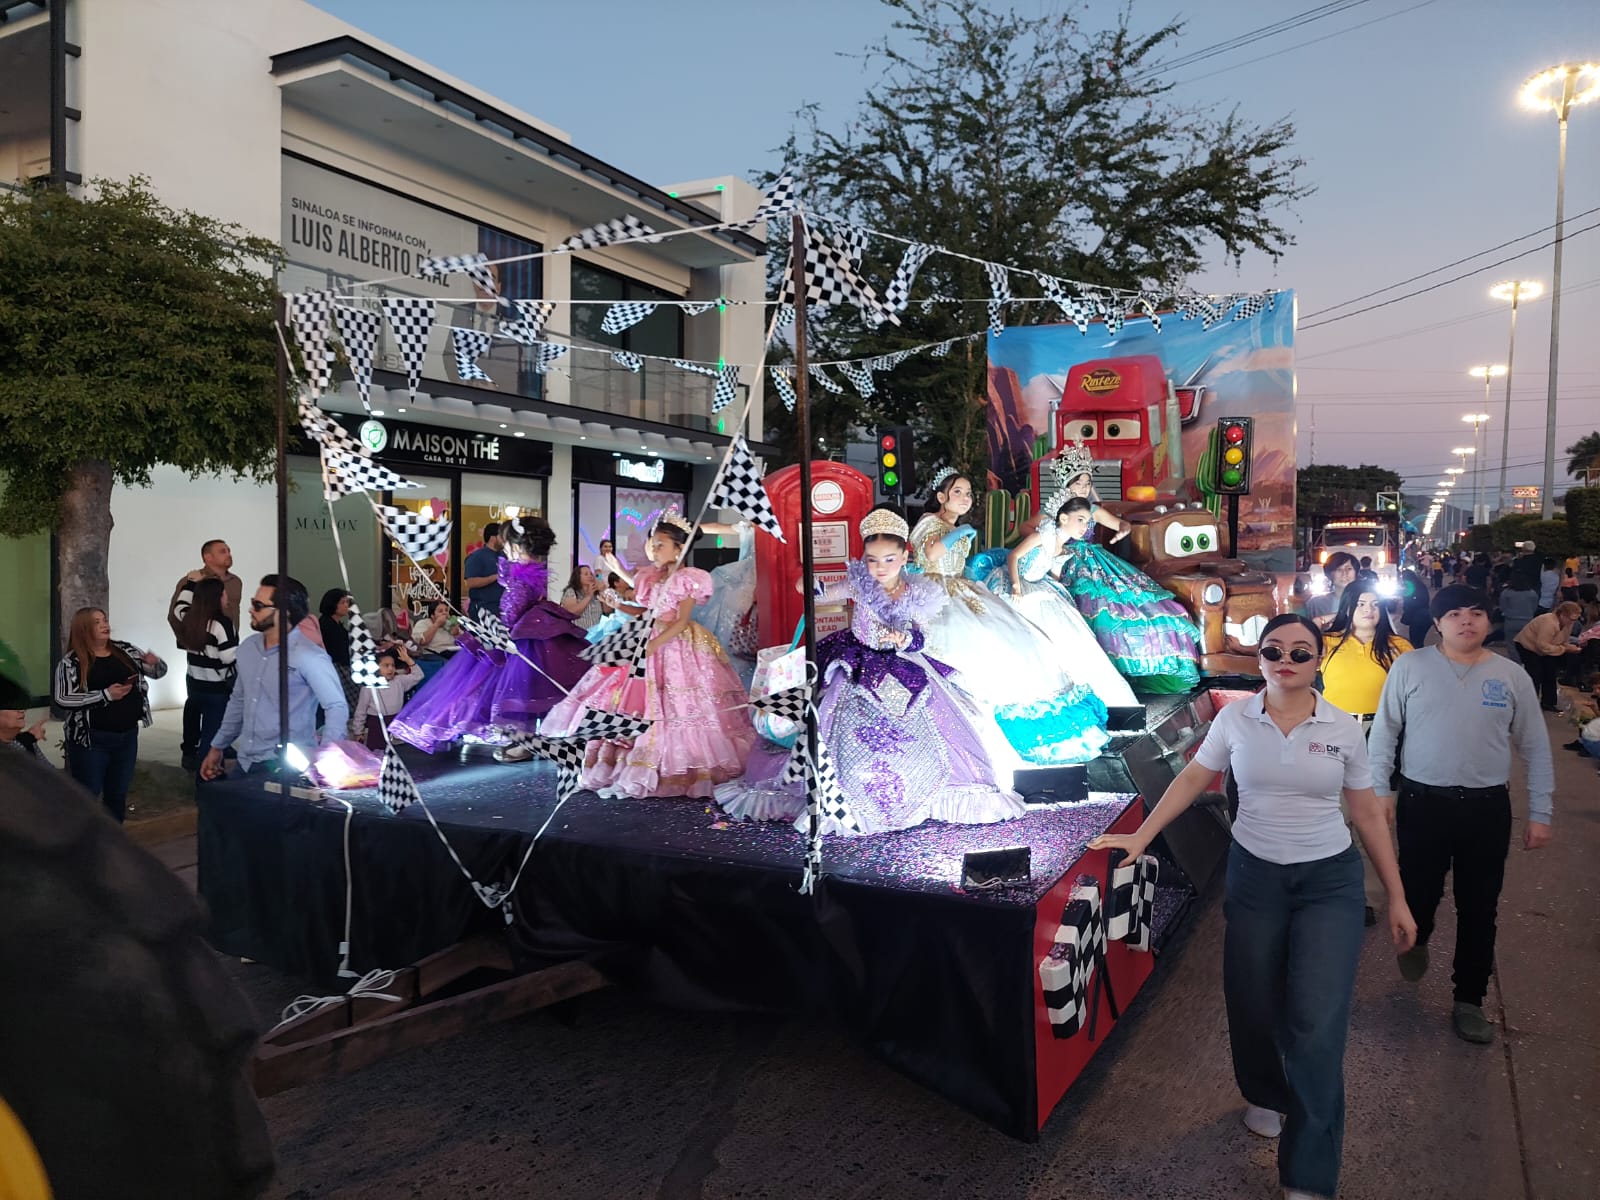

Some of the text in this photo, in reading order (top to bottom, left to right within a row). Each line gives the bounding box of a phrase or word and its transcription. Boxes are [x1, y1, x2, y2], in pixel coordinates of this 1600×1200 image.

[291, 197, 426, 249] SINALOA SE INFORMA CON
[291, 213, 333, 253] LUIS
[338, 229, 411, 276] ALBERTO
[393, 429, 500, 460] MAISON THÉ
[423, 454, 442, 462] CASA
[814, 615, 847, 625] ONTAINS
[817, 624, 838, 632] LEAD
[1326, 744, 1341, 754] DIF
